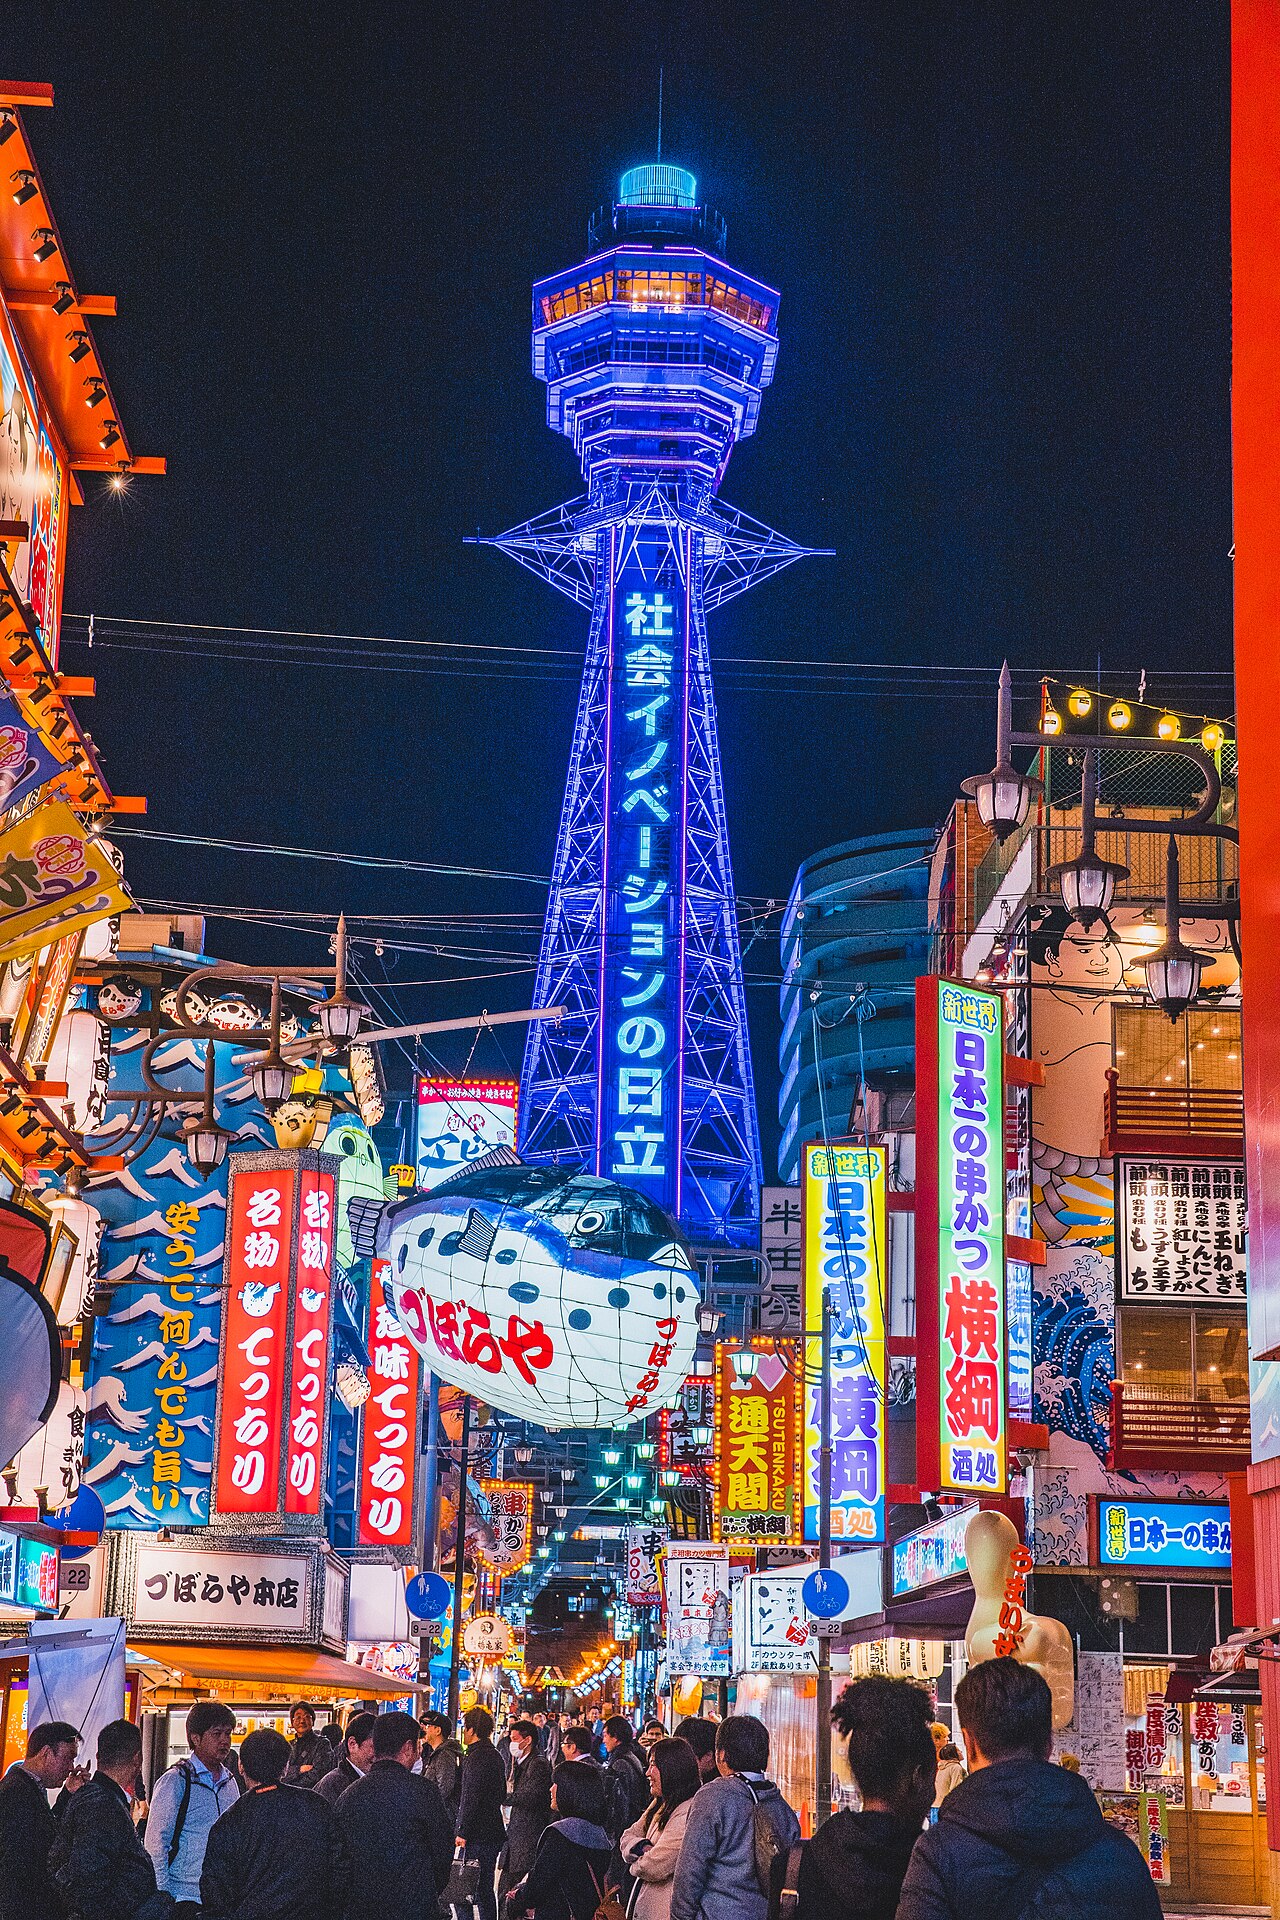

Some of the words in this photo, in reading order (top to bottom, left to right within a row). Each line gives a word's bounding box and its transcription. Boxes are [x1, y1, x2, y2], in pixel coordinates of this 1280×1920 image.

[612, 593, 673, 1175] 社会イノベーションの日立
[944, 993, 996, 1033] 新世界
[812, 1152, 878, 1177] 新世界
[952, 1033, 988, 1270] 日本一の串かつ
[1171, 1167, 1190, 1199] 前頭
[1192, 1168, 1211, 1199] 前頭
[1213, 1169, 1232, 1200] 前頭
[245, 1188, 282, 1269] 名物
[301, 1190, 331, 1270] 名物
[1130, 1227, 1149, 1292] もち
[1172, 1229, 1193, 1292] 紅しょうが
[1192, 1230, 1212, 1293] にんにく
[1213, 1230, 1234, 1294] 玉ねぎ
[151, 1201, 201, 1510] 安うて何んでも旨い
[400, 1287, 554, 1386] づぼらや
[625, 1317, 681, 1413] づぼらや
[945, 1278, 999, 1441] 横綱
[231, 1327, 271, 1495] てっちり
[290, 1328, 325, 1496] てっちり
[810, 1376, 878, 1502] 横綱
[728, 1395, 770, 1511] 通天閣
[772, 1395, 786, 1511] TSUTENKAKU
[951, 1447, 997, 1485] 酒処
[503, 1491, 526, 1551] 串かつ
[1109, 1508, 1126, 1557] 新世界
[144, 1570, 300, 1609] づぼらや本店
[1146, 1692, 1166, 1768] 二度漬け
